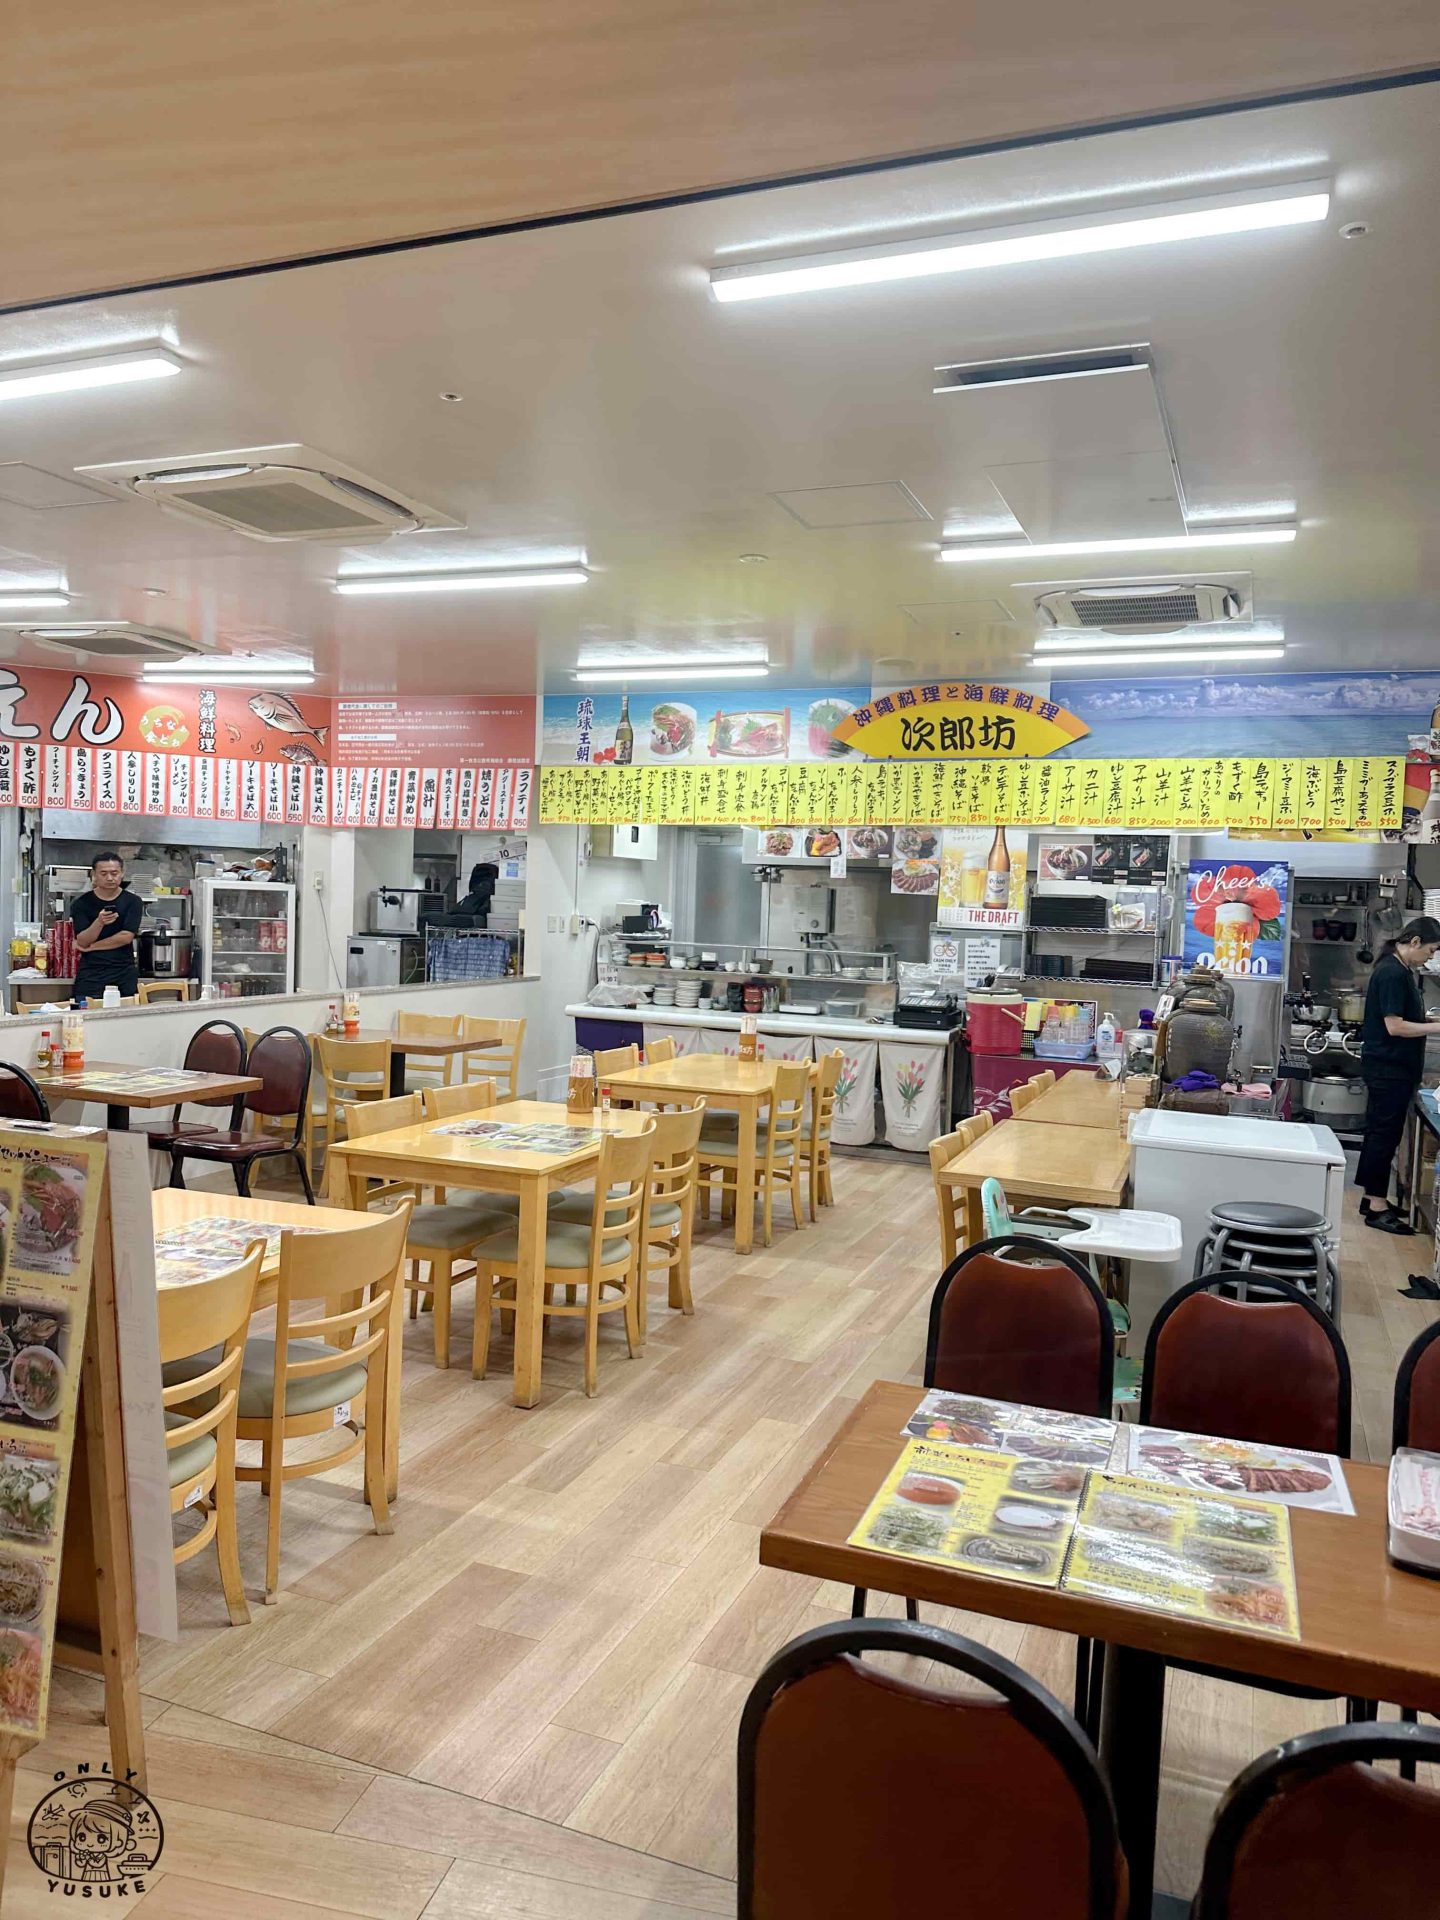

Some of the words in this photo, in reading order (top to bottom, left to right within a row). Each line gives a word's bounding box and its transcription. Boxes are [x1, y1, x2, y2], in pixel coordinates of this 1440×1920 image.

[0, 668, 124, 745] えん
[199, 689, 217, 753] 海鮮料理
[853, 684, 1060, 727] 沖縄料理と海鮮料理
[575, 698, 593, 763] 琉球王朝
[900, 715, 1016, 751] 次郎坊
[23, 745, 36, 794] もずく酢
[77, 748, 86, 798] 島らっきょう
[102, 752, 112, 799] タコライス
[127, 752, 137, 802] 人参しりしり
[152, 754, 160, 803] ヘチマ味噌炒め
[246, 761, 255, 810] ソーキそば大
[270, 763, 278, 812] ソーキそば小
[760, 766, 769, 807] グルクンの
[778, 765, 788, 792] ゴーヤー
[798, 767, 808, 795] 豆腐
[817, 768, 826, 801] ソーメン
[876, 764, 887, 807] 島ラッキョー
[951, 765, 967, 810] 沖縄そば
[1060, 765, 1076, 812] アーサ汁
[1084, 768, 1100, 806] カニ汁
[1131, 764, 1148, 810] アサリ汁
[1154, 767, 1171, 807] 山羊汁
[1178, 765, 1195, 811] 山羊さしみ
[1214, 760, 1224, 796] あさりの
[1228, 761, 1246, 803] もずく酢
[1252, 762, 1269, 811] 島ラッキョー
[1280, 762, 1293, 814] ジーマミー豆ふ
[1305, 764, 1321, 808] 海ぶどう
[1330, 760, 1347, 816] 島豆腐やっこ
[1382, 760, 1399, 816] スクガラス豆ふ
[0, 794, 12, 803] 00
[22, 796, 38, 804] 500
[47, 797, 64, 805] 800
[73, 799, 90, 807] 550
[100, 801, 115, 809] 800
[123, 802, 139, 811] 800
[290, 766, 301, 812] 沖縄そば小
[314, 768, 324, 813] 沖縄そば大
[405, 770, 416, 815] 青菜炒め
[423, 778, 435, 808] 魚汁
[444, 769, 453, 818] 牛肉ステーキ
[462, 770, 472, 817] 魚の塩焼き
[479, 769, 491, 818] 焼うどん
[499, 768, 508, 819] アグーステーキ
[517, 770, 530, 814] ラフティ
[608, 785, 617, 816] ソーセージ
[698, 772, 711, 806] 海鮮丼
[716, 768, 729, 814] 刺身盛合せ
[734, 769, 748, 812] 刺身定食
[849, 765, 863, 818] 人参しりしり
[930, 762, 945, 817] 海鮮やきそば
[969, 775, 984, 813] ソーキそば
[1016, 762, 1031, 817] ゆし豆ふそば
[1039, 765, 1052, 815] 醤油ラーメン
[1107, 762, 1124, 816] ゆし豆腐汁
[1358, 760, 1373, 820] ミミガーあえもの
[148, 804, 164, 813] 850
[172, 806, 188, 814] 800
[197, 808, 212, 816] 800
[220, 809, 235, 817] 850
[243, 810, 258, 818] 800
[267, 812, 281, 820] 600
[288, 813, 302, 821] 550
[311, 815, 325, 823] 700
[440, 818, 454, 827] 1500
[477, 818, 489, 827] 800
[493, 819, 509, 827] 1600
[513, 818, 527, 827] 950
[970, 814, 987, 822] 850
[994, 815, 1009, 824] 900
[1058, 814, 1076, 823] 680
[1104, 816, 1122, 824] 680
[1128, 816, 1147, 825] 850
[1175, 817, 1196, 825] 2000
[1225, 816, 1243, 824] 500
[1249, 815, 1268, 825] 550
[1300, 817, 1321, 826] 700
[1328, 817, 1346, 826] 500
[1355, 820, 1372, 828] 500
[1379, 817, 1398, 826] 550
[499, 849, 510, 858] 10
[1195, 865, 1276, 903] Cheers!
[968, 910, 987, 922] THE
[987, 910, 1019, 924] DRAFT
[1196, 947, 1267, 975] Orion
